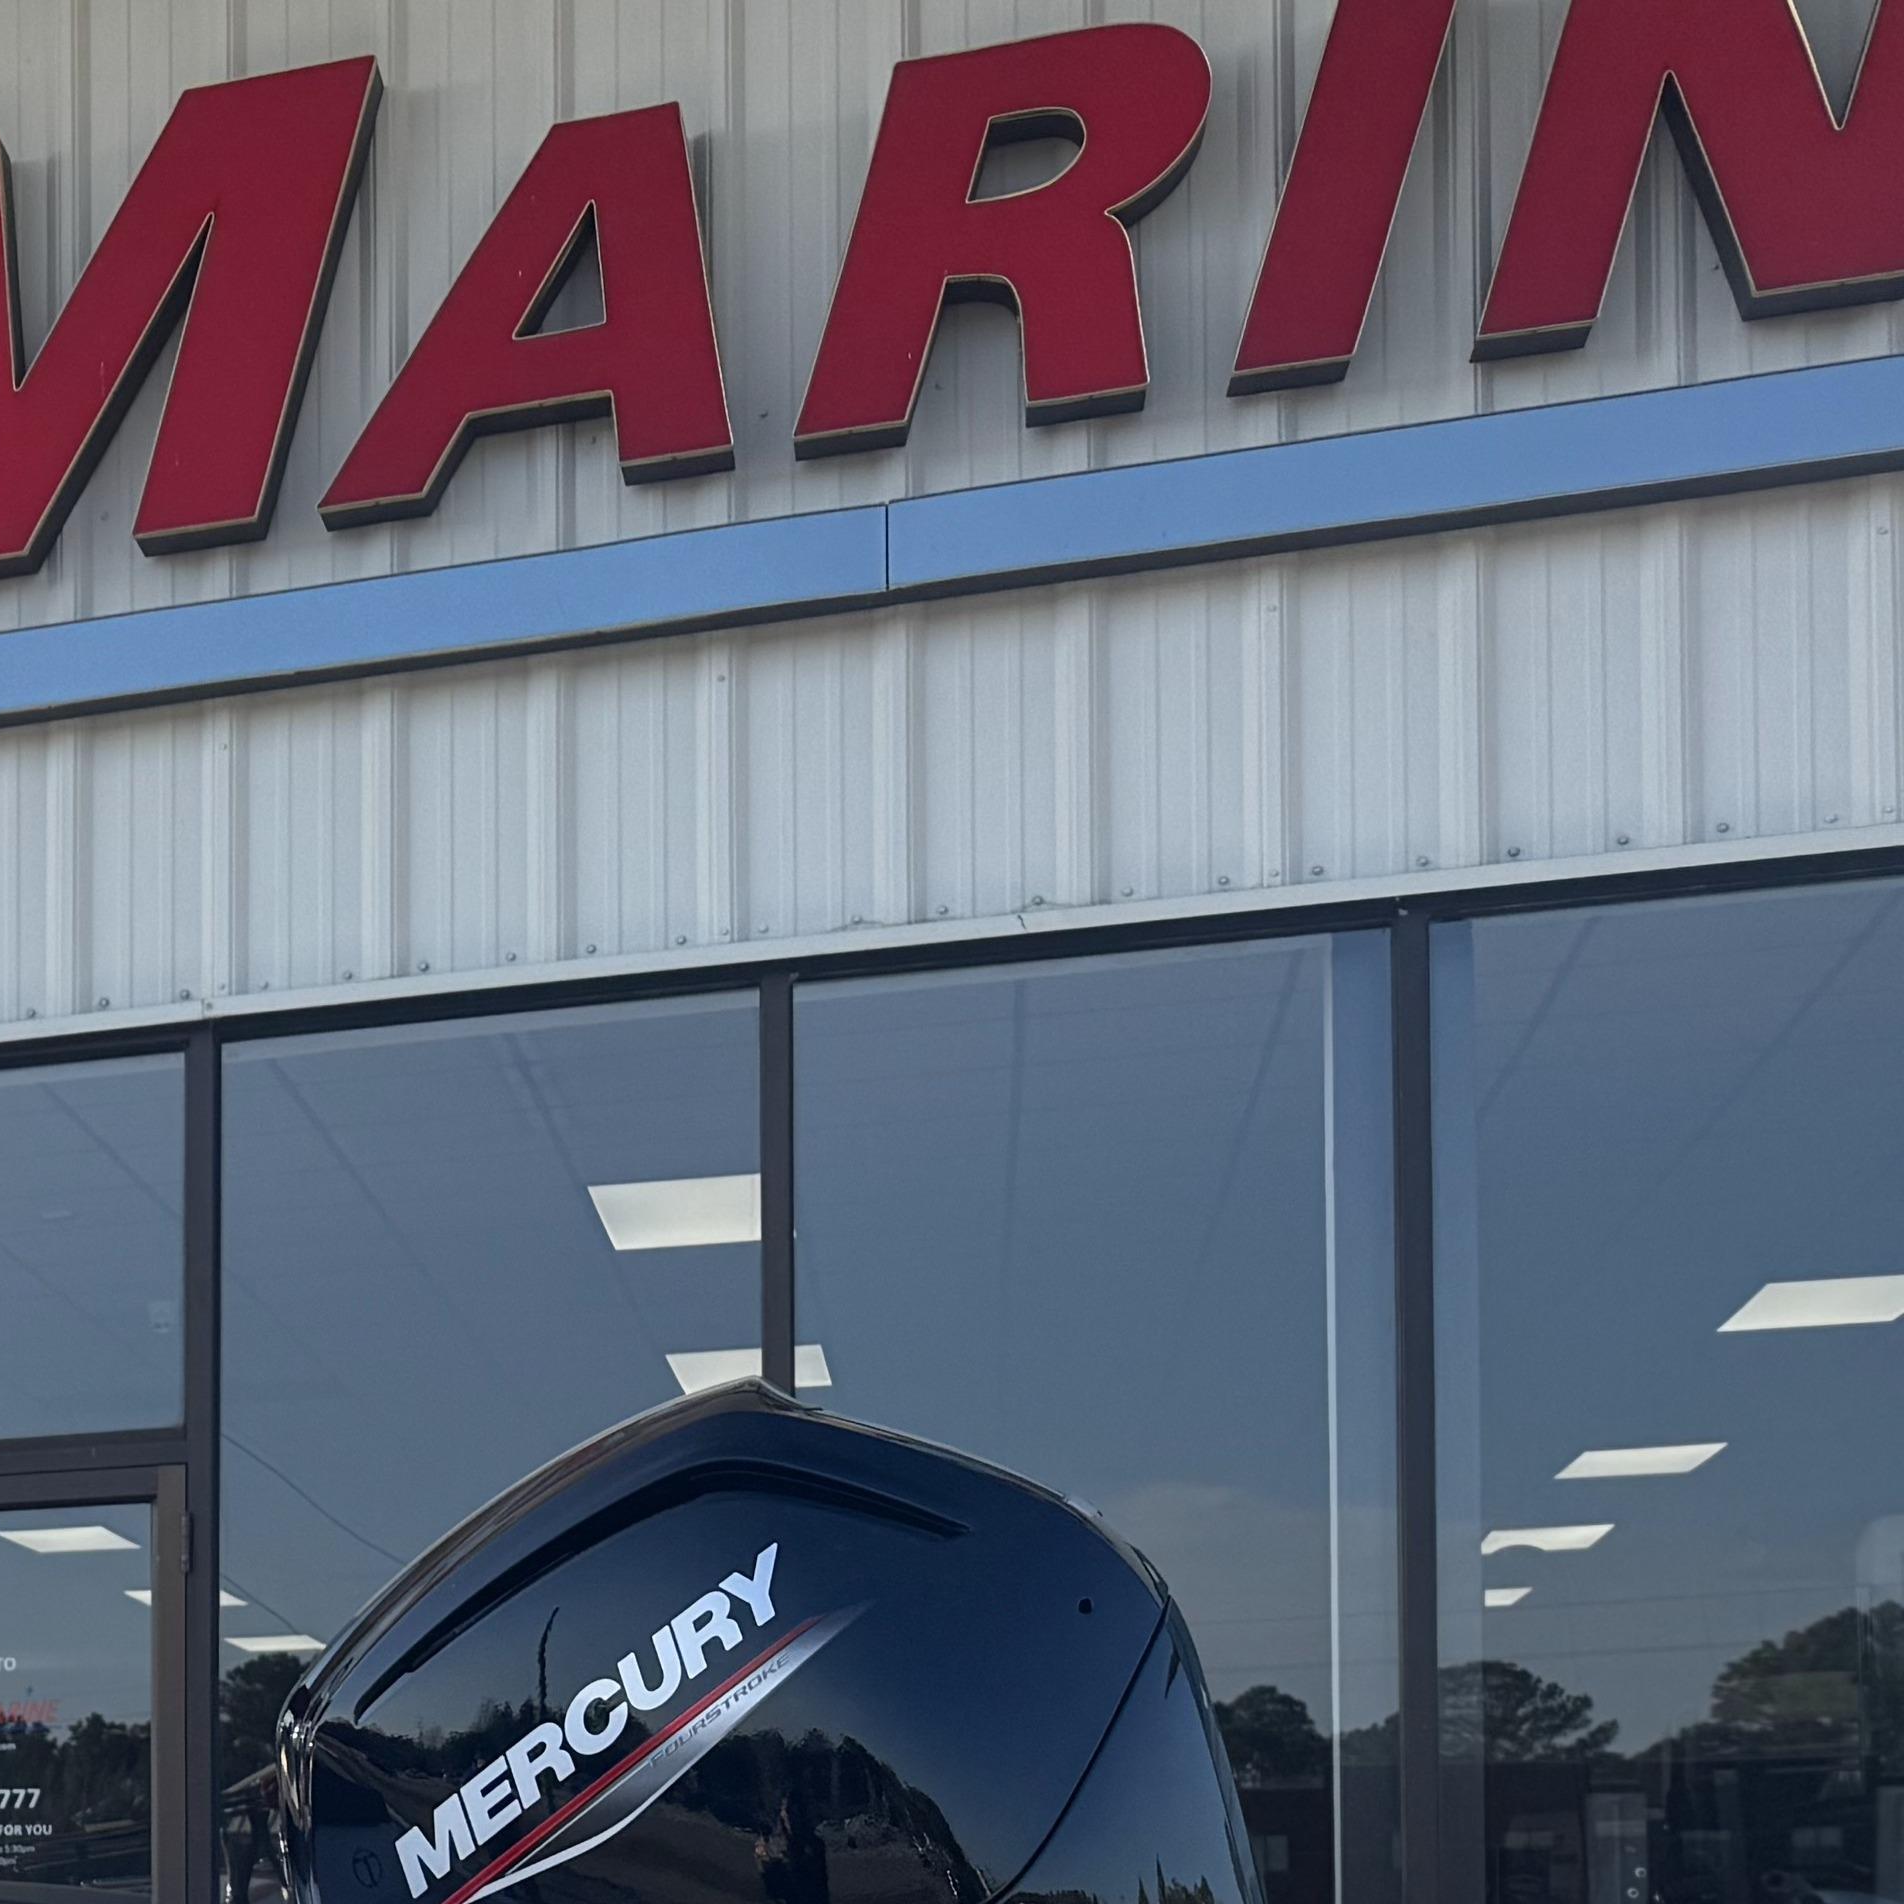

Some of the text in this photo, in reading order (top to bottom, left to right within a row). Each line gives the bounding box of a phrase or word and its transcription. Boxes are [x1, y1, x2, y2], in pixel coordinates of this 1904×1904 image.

[395, 1542, 778, 1900] MERCURY
[648, 1653, 793, 1768] FOURSTROKE
[25, 1824, 53, 1836] YOU
